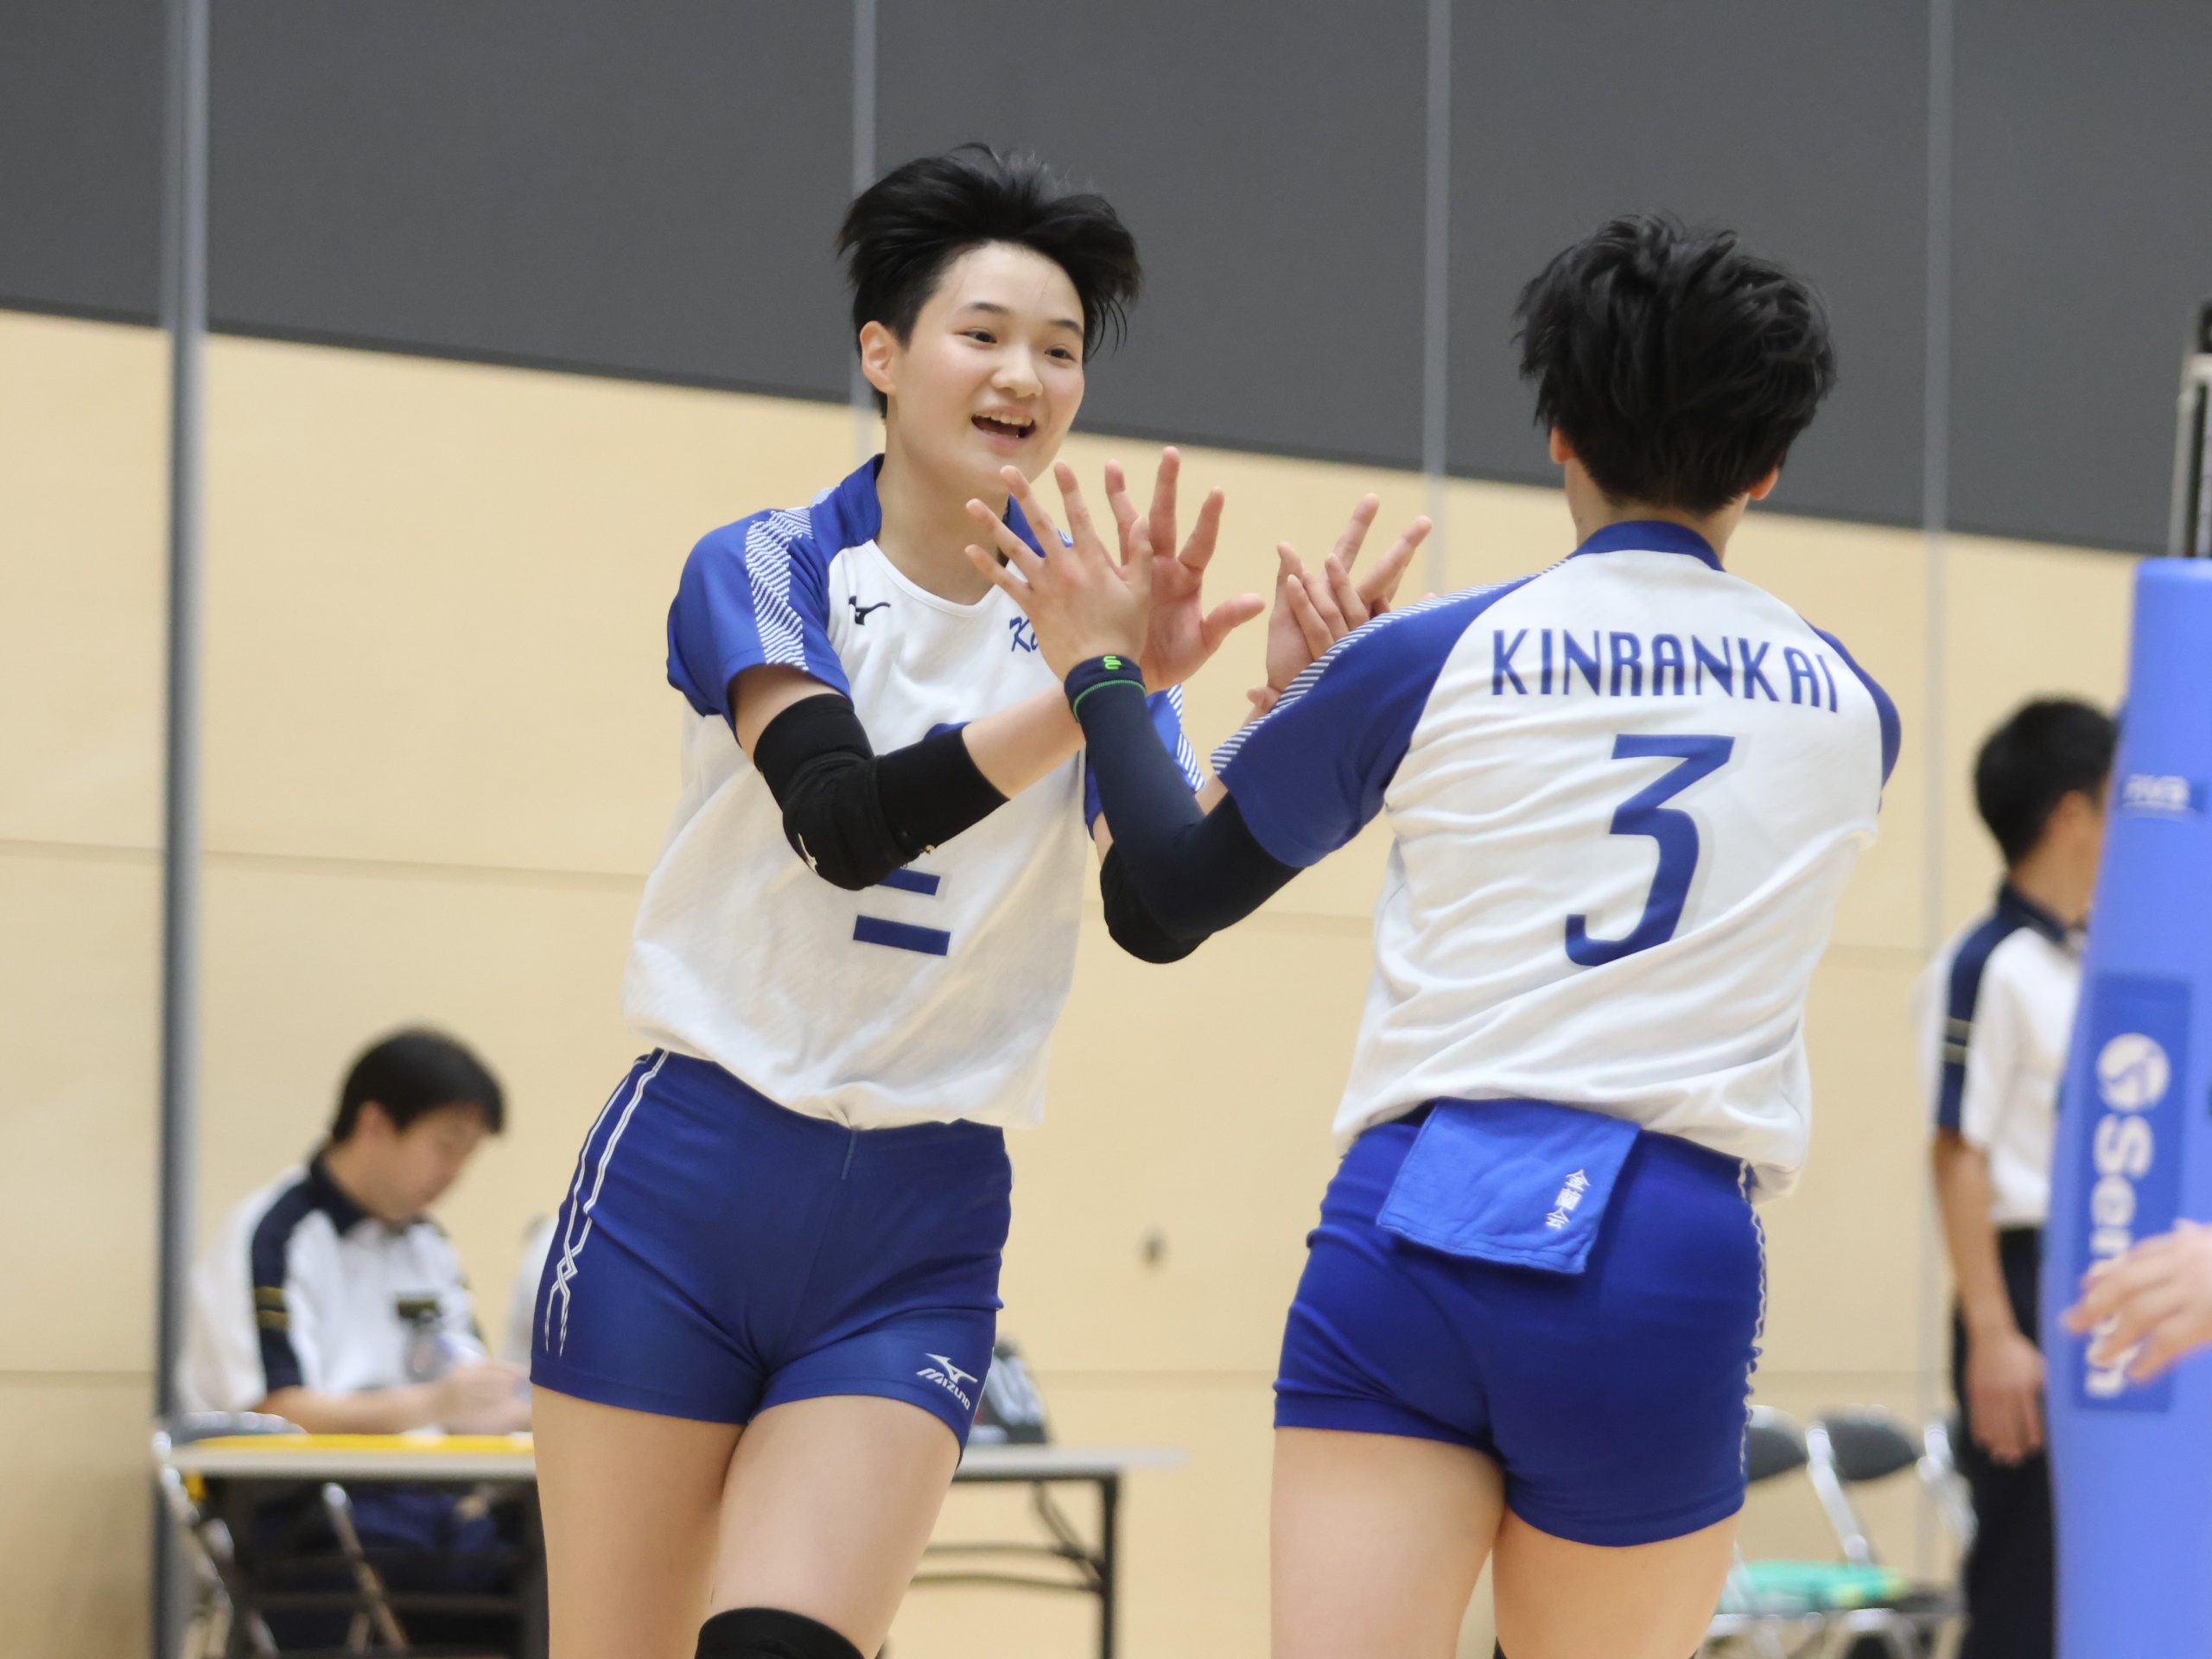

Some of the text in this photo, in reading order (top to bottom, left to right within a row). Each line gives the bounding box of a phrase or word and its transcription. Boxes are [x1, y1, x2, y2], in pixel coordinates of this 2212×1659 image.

[1492, 628, 1838, 713] KINRANKAI
[1565, 734, 1736, 967] 3
[916, 1368, 970, 1410] MIZUNO
